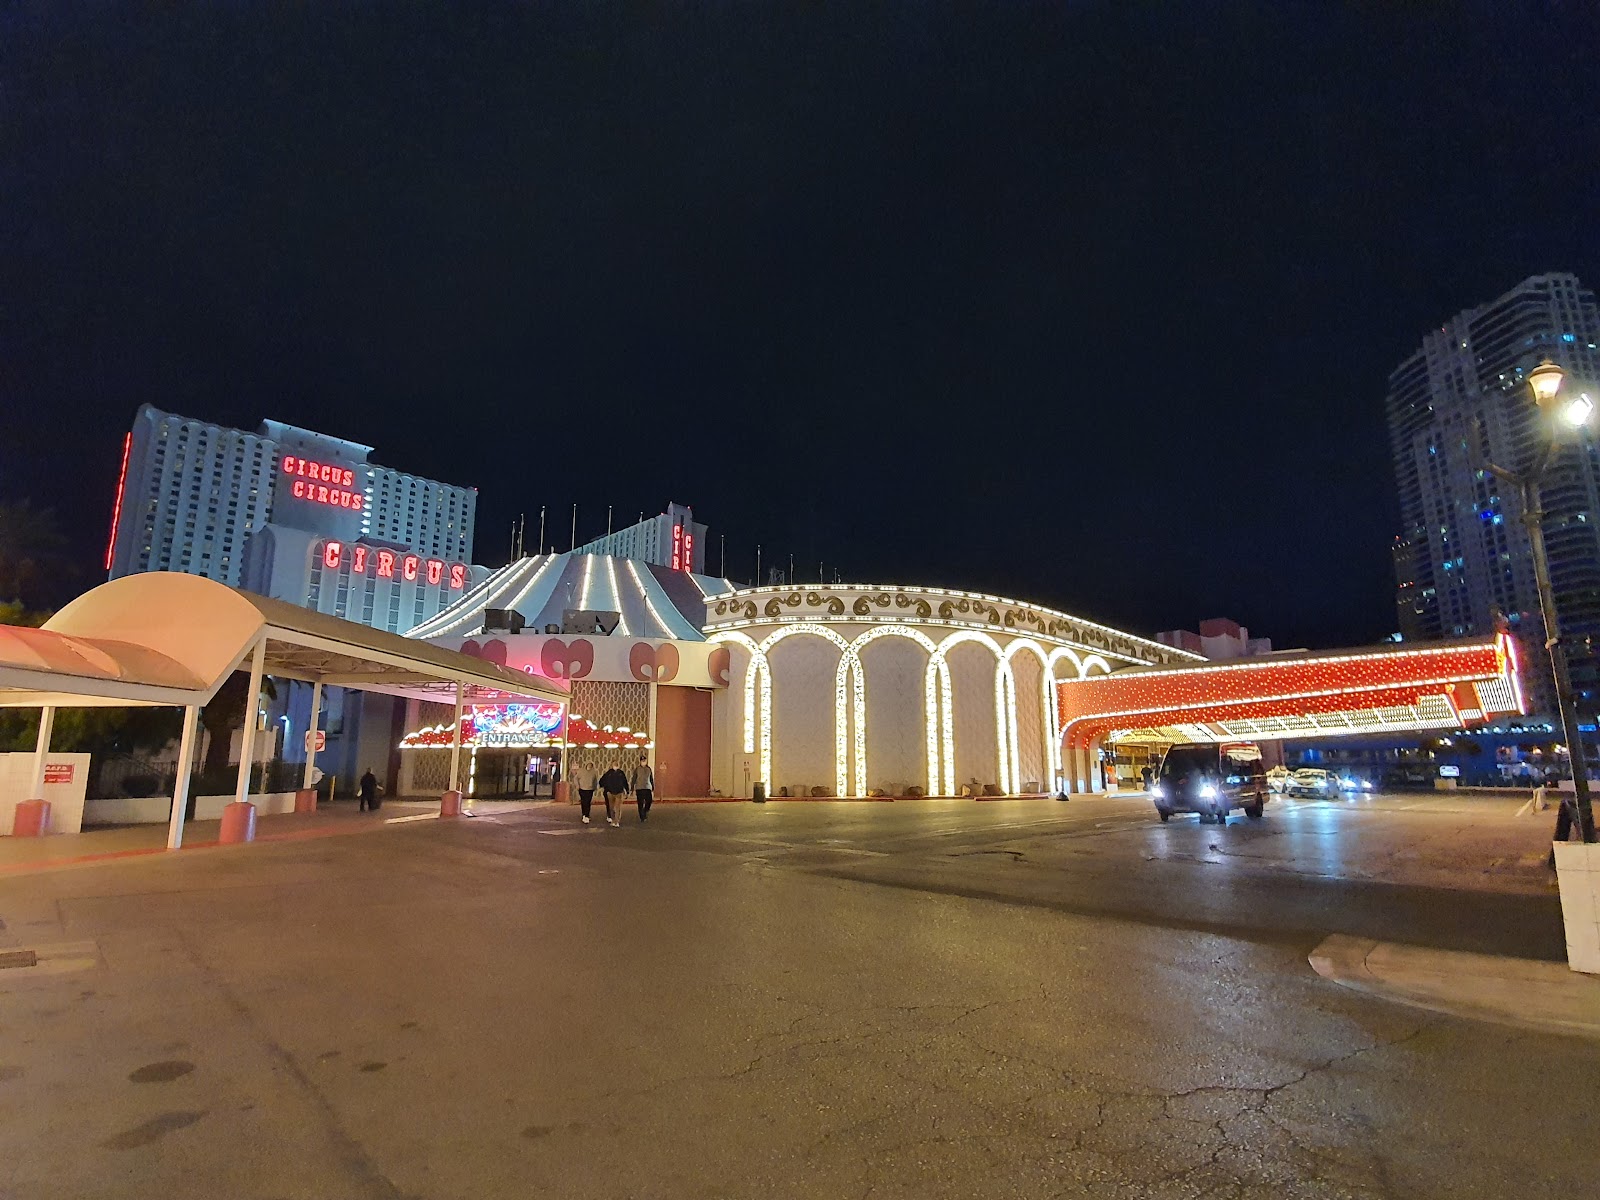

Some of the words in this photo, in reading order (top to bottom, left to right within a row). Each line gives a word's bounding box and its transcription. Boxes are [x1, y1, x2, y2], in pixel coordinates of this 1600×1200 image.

[284, 456, 353, 486] CIRCUS
[293, 481, 362, 510] CIRCUS
[325, 542, 464, 588] CIRCUS
[482, 733, 541, 742] ENTRANCE
